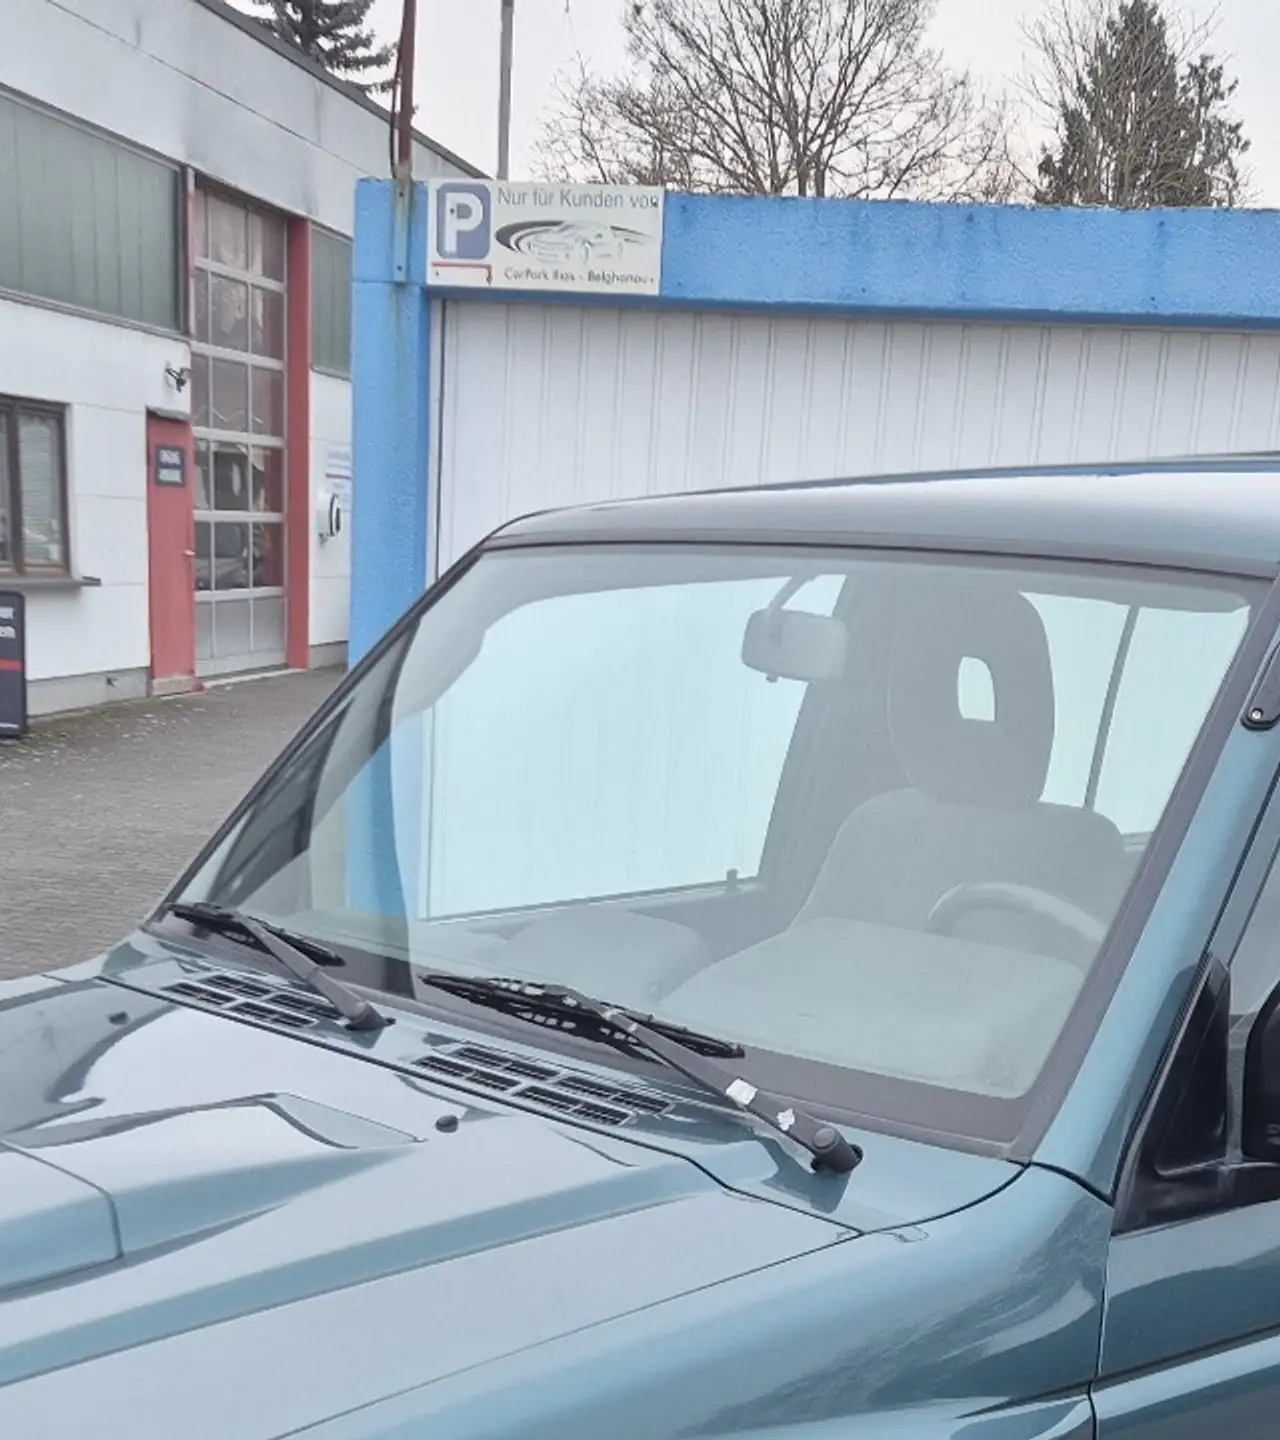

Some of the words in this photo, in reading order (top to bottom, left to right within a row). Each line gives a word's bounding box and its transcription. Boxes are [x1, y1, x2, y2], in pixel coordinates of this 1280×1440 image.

[498, 187, 528, 205] Nur
[533, 188, 555, 207] für
[560, 188, 624, 208] Kunden
